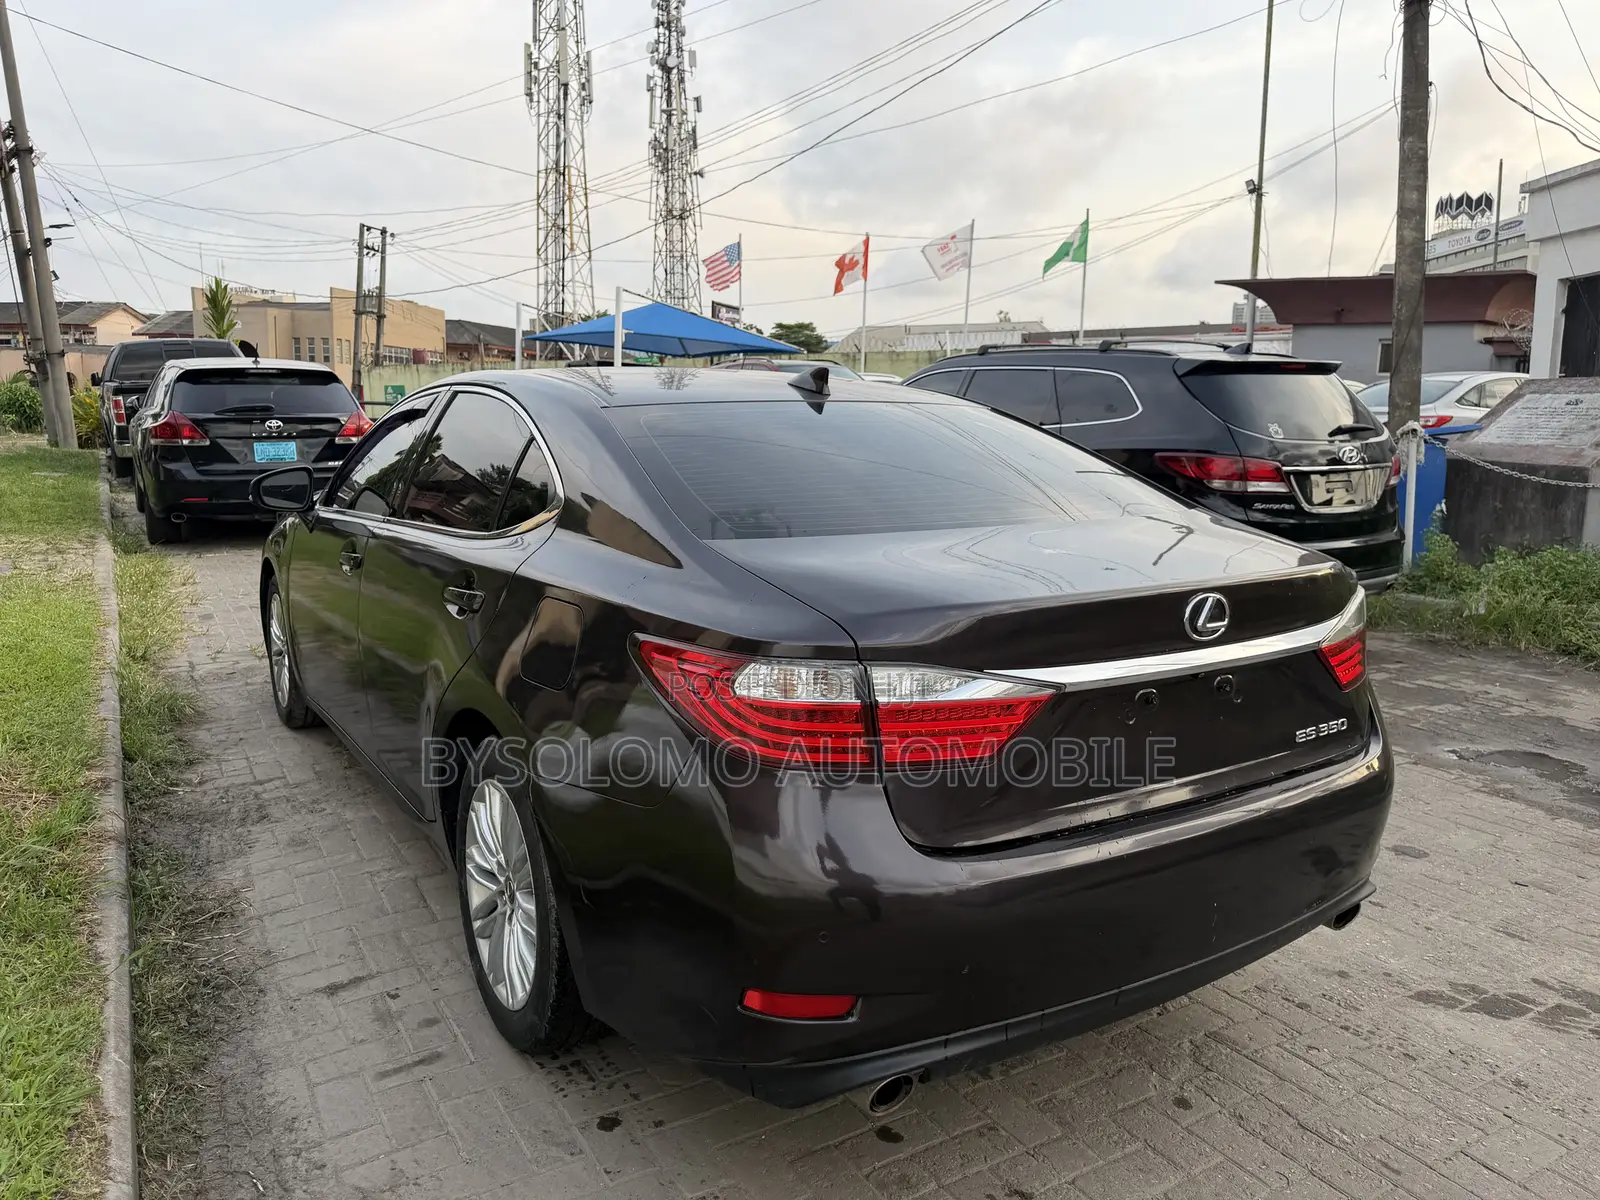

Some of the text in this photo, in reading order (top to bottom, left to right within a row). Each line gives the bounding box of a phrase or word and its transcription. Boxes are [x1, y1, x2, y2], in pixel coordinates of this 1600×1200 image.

[1447, 236, 1472, 249] TOYOTA
[1295, 718, 1348, 743] ES 350
